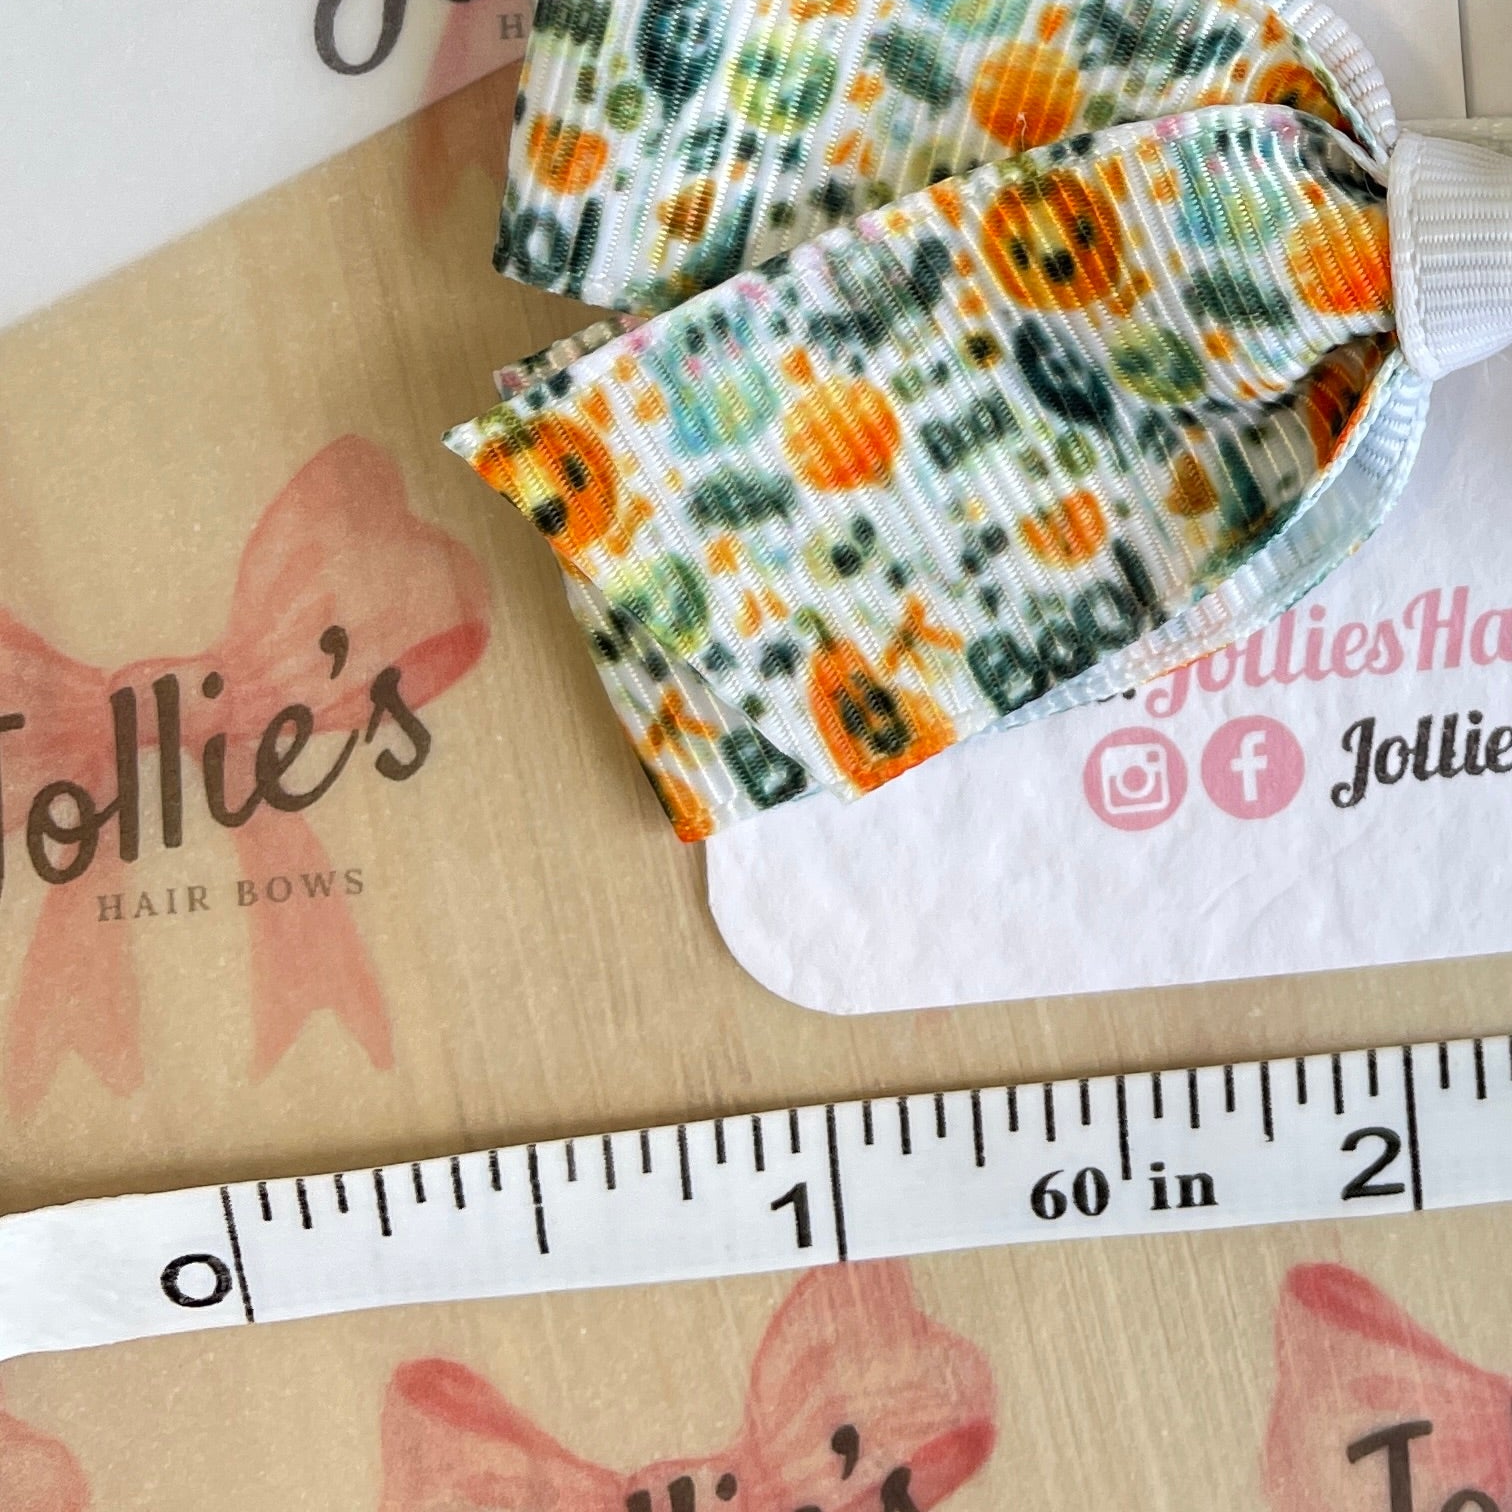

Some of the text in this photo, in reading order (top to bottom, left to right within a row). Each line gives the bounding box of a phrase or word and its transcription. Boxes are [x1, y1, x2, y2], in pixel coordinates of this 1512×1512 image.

[0, 625, 432, 886] ollie's
[97, 867, 365, 922] HAIR BOWS
[1029, 1162, 1219, 1220] 60 in
[1341, 1126, 1406, 1201] 2
[770, 1182, 813, 1248] 1
[160, 1253, 232, 1308] 0
